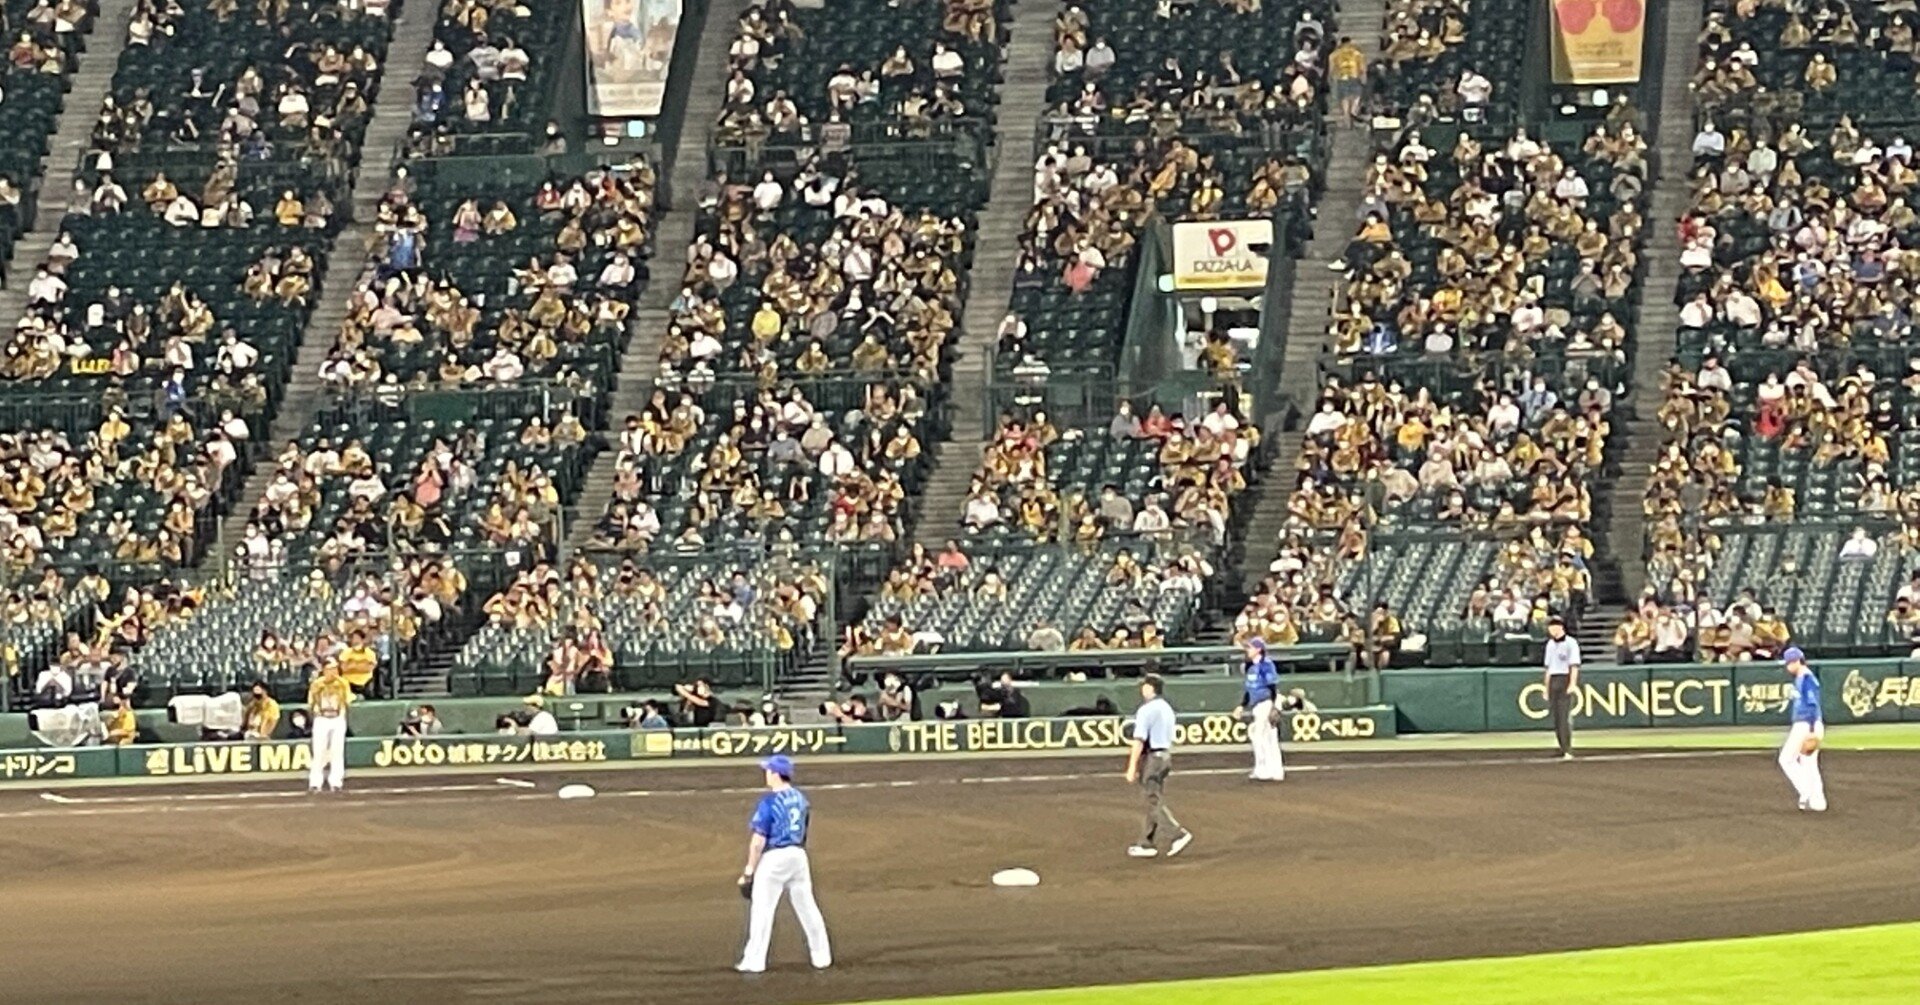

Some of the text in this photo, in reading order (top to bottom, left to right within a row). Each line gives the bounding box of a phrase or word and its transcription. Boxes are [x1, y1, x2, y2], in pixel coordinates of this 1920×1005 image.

[902, 723, 959, 752] THE
[1321, 716, 1375, 737] ベルコ
[259, 744, 312, 771] MA
[375, 740, 445, 766] Joto
[789, 807, 800, 831] 2
